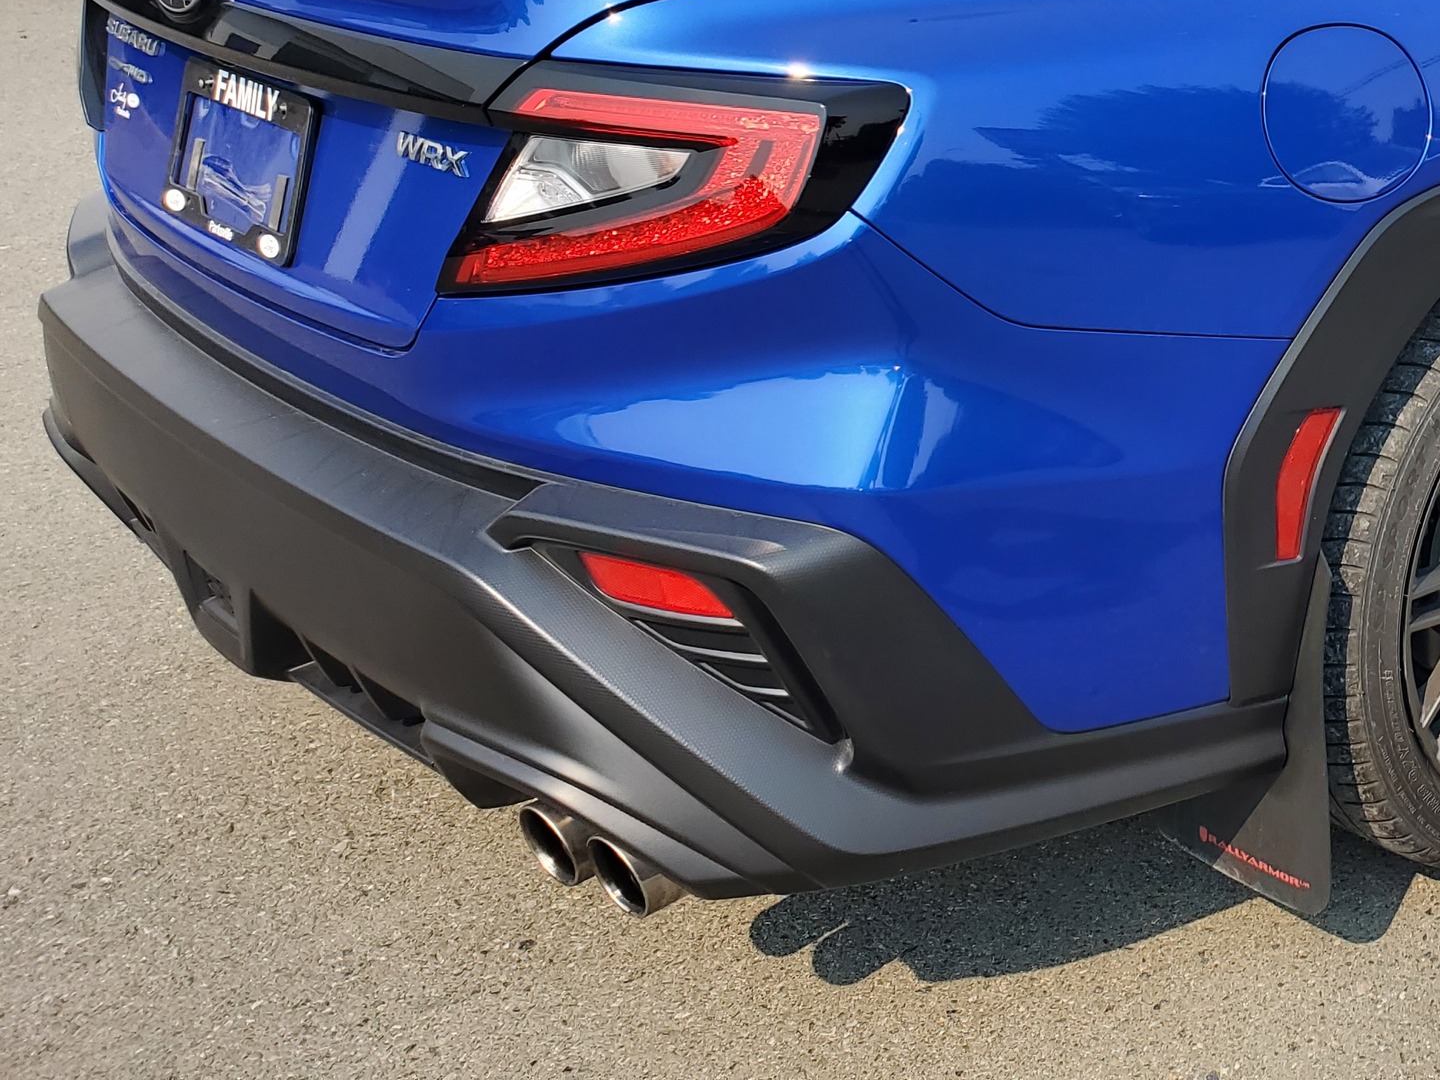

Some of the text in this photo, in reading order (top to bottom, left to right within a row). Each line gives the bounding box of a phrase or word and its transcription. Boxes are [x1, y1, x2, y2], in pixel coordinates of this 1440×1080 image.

[106, 18, 158, 57] SUBARU
[214, 68, 280, 122] FAMILY
[397, 130, 469, 178] WRX
